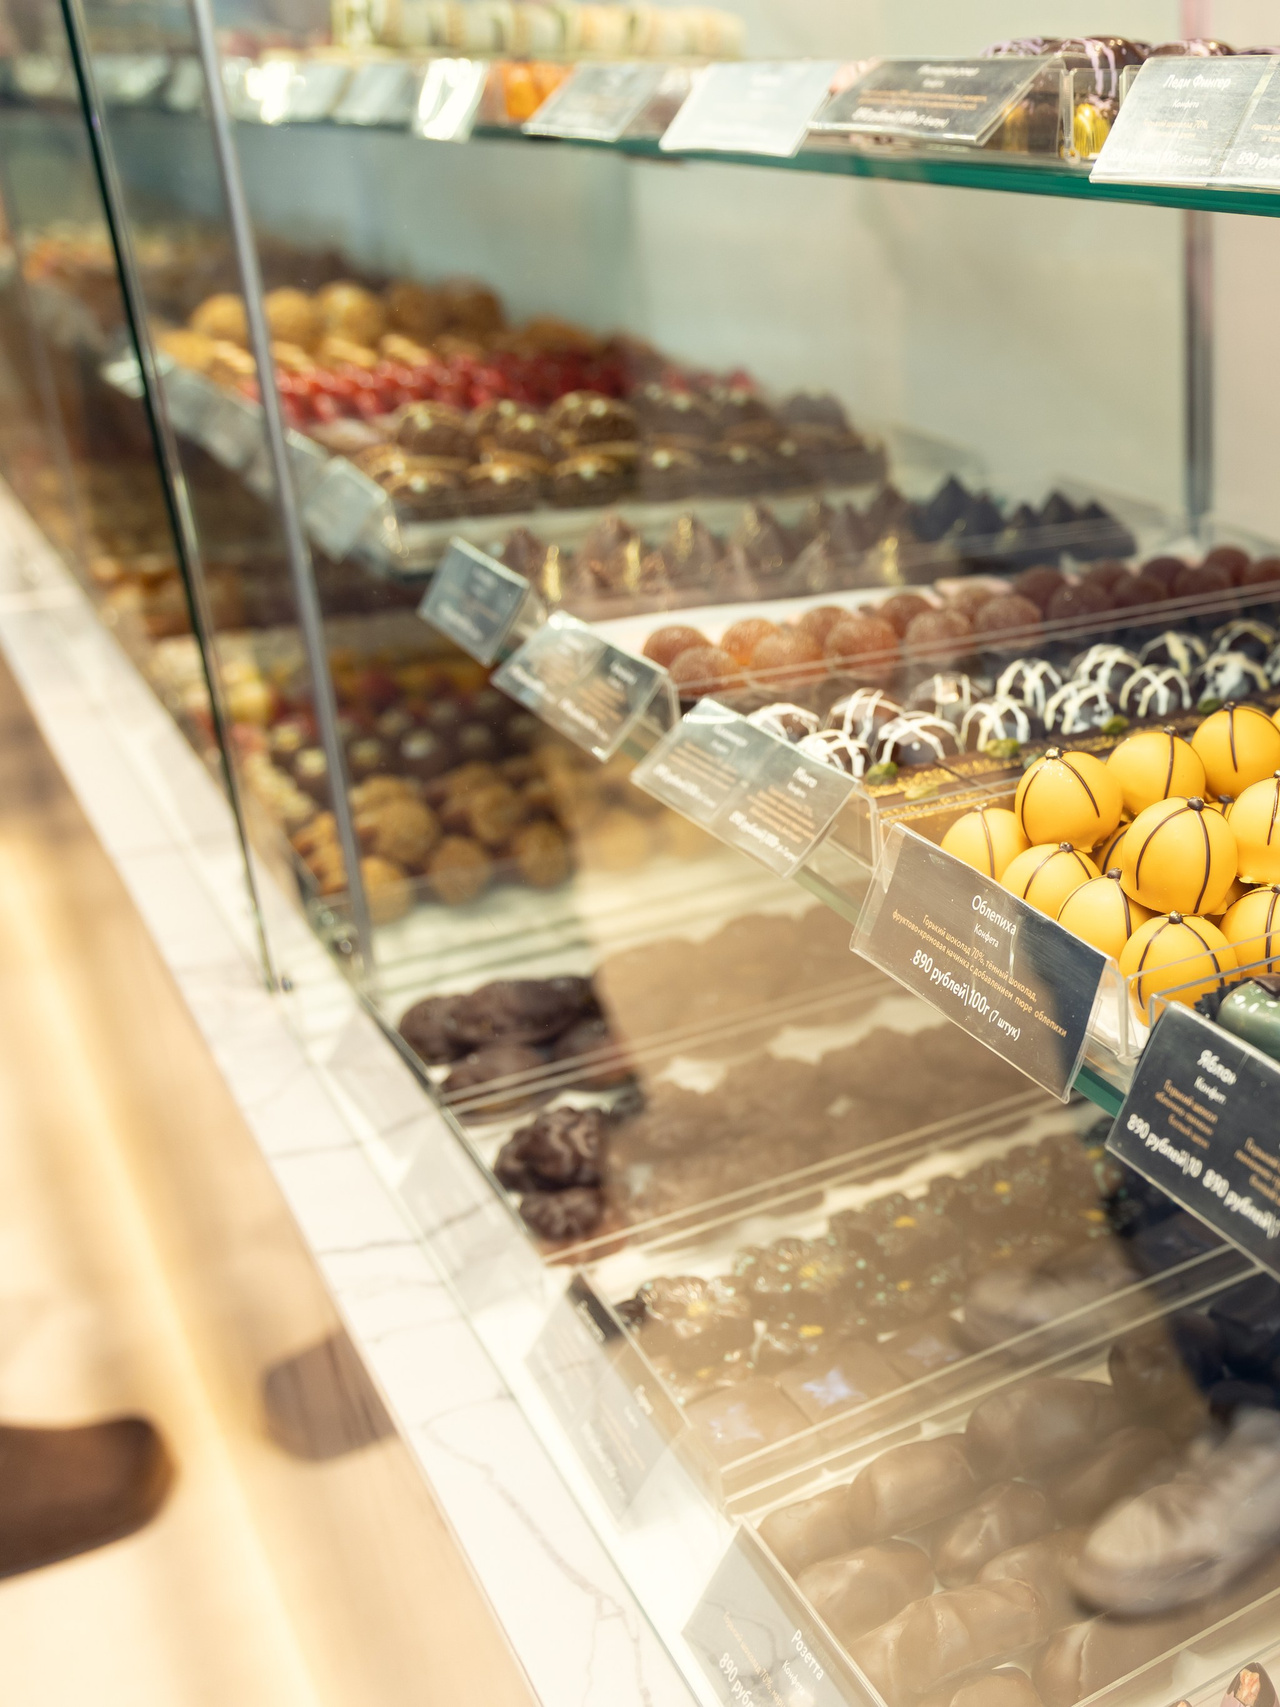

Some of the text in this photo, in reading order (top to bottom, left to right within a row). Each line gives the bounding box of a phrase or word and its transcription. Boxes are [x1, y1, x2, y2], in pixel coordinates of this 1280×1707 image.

[1163, 73, 1232, 91] Леди Фингер
[1236, 152, 1259, 166] 890
[972, 895, 1017, 936] Облепиха
[974, 923, 999, 948] Конфета
[922, 914, 1037, 1003] Горький шоколад 70%, тёмный шоколад,
[912, 949, 1021, 1042] 890 рублей\100г (7 штук)
[945, 949, 970, 969] начинка
[972, 970, 1014, 1000] добавлением
[1014, 996, 1033, 1014] пюре
[1034, 1010, 1067, 1038] облепихи
[1126, 1113, 1151, 1140] 890
[1202, 1168, 1230, 1198] 890
[719, 1652, 738, 1683] 890
[791, 1629, 825, 1681] Розетта
